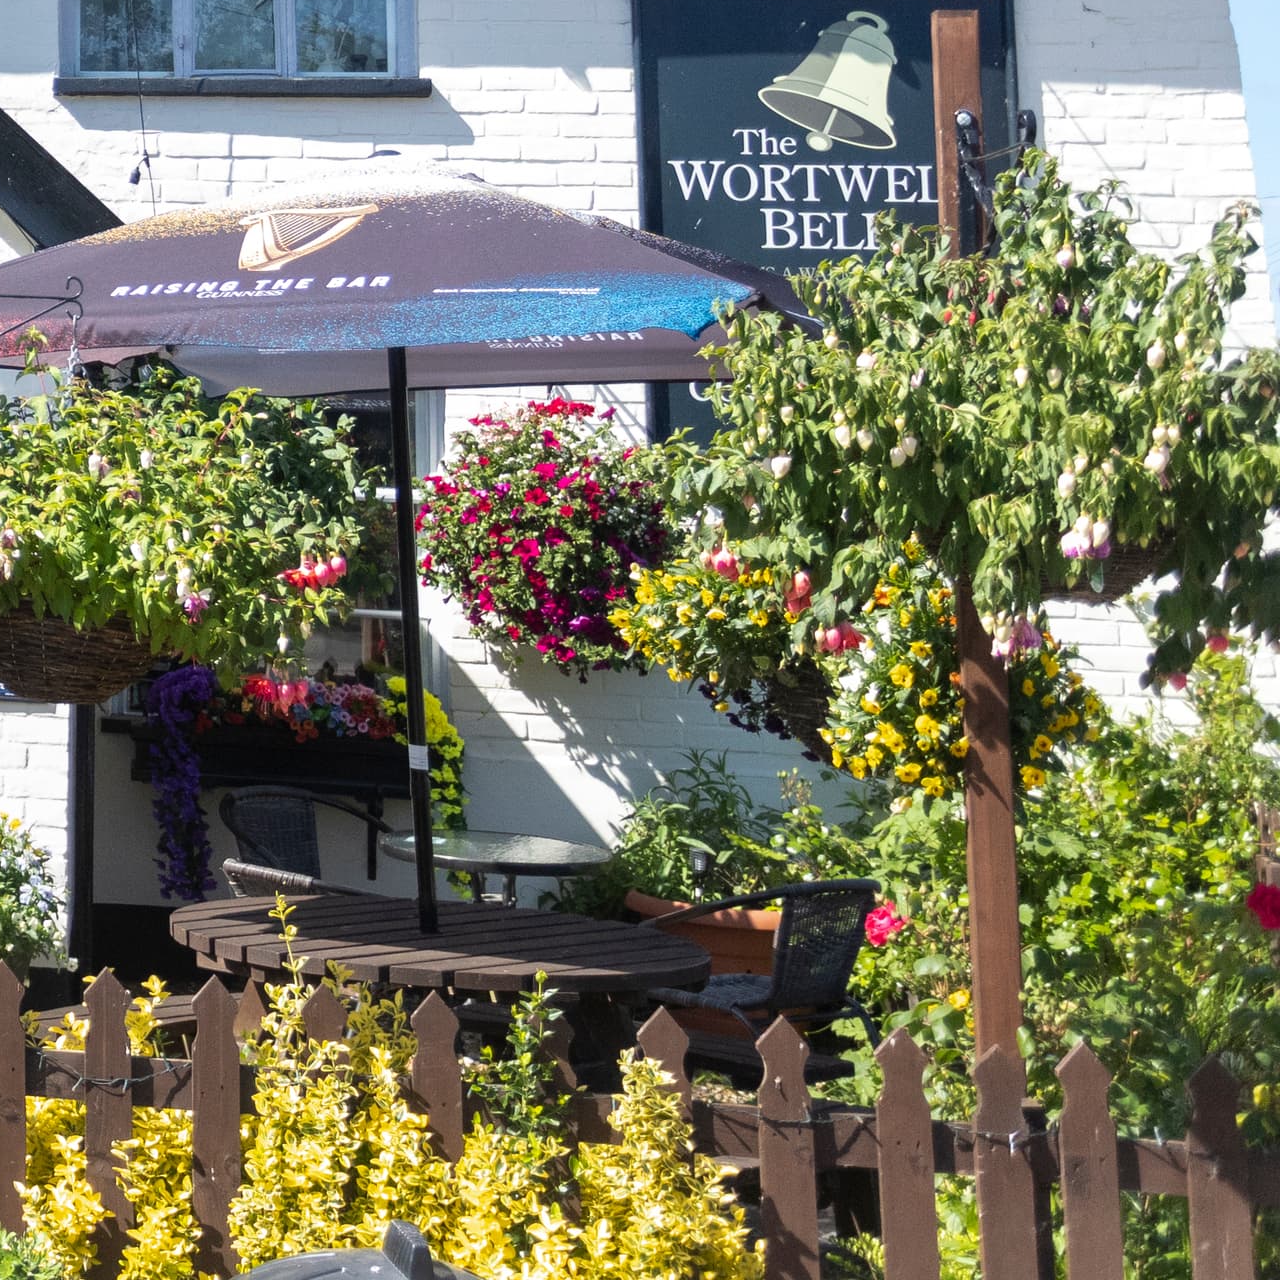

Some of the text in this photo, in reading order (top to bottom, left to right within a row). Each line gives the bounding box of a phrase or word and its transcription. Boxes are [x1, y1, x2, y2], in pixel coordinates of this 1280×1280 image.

[732, 128, 797, 156] The
[667, 160, 939, 203] WORTWEL
[110, 275, 391, 297] RAISING THE BAR
[196, 289, 285, 299] GUINNESS
